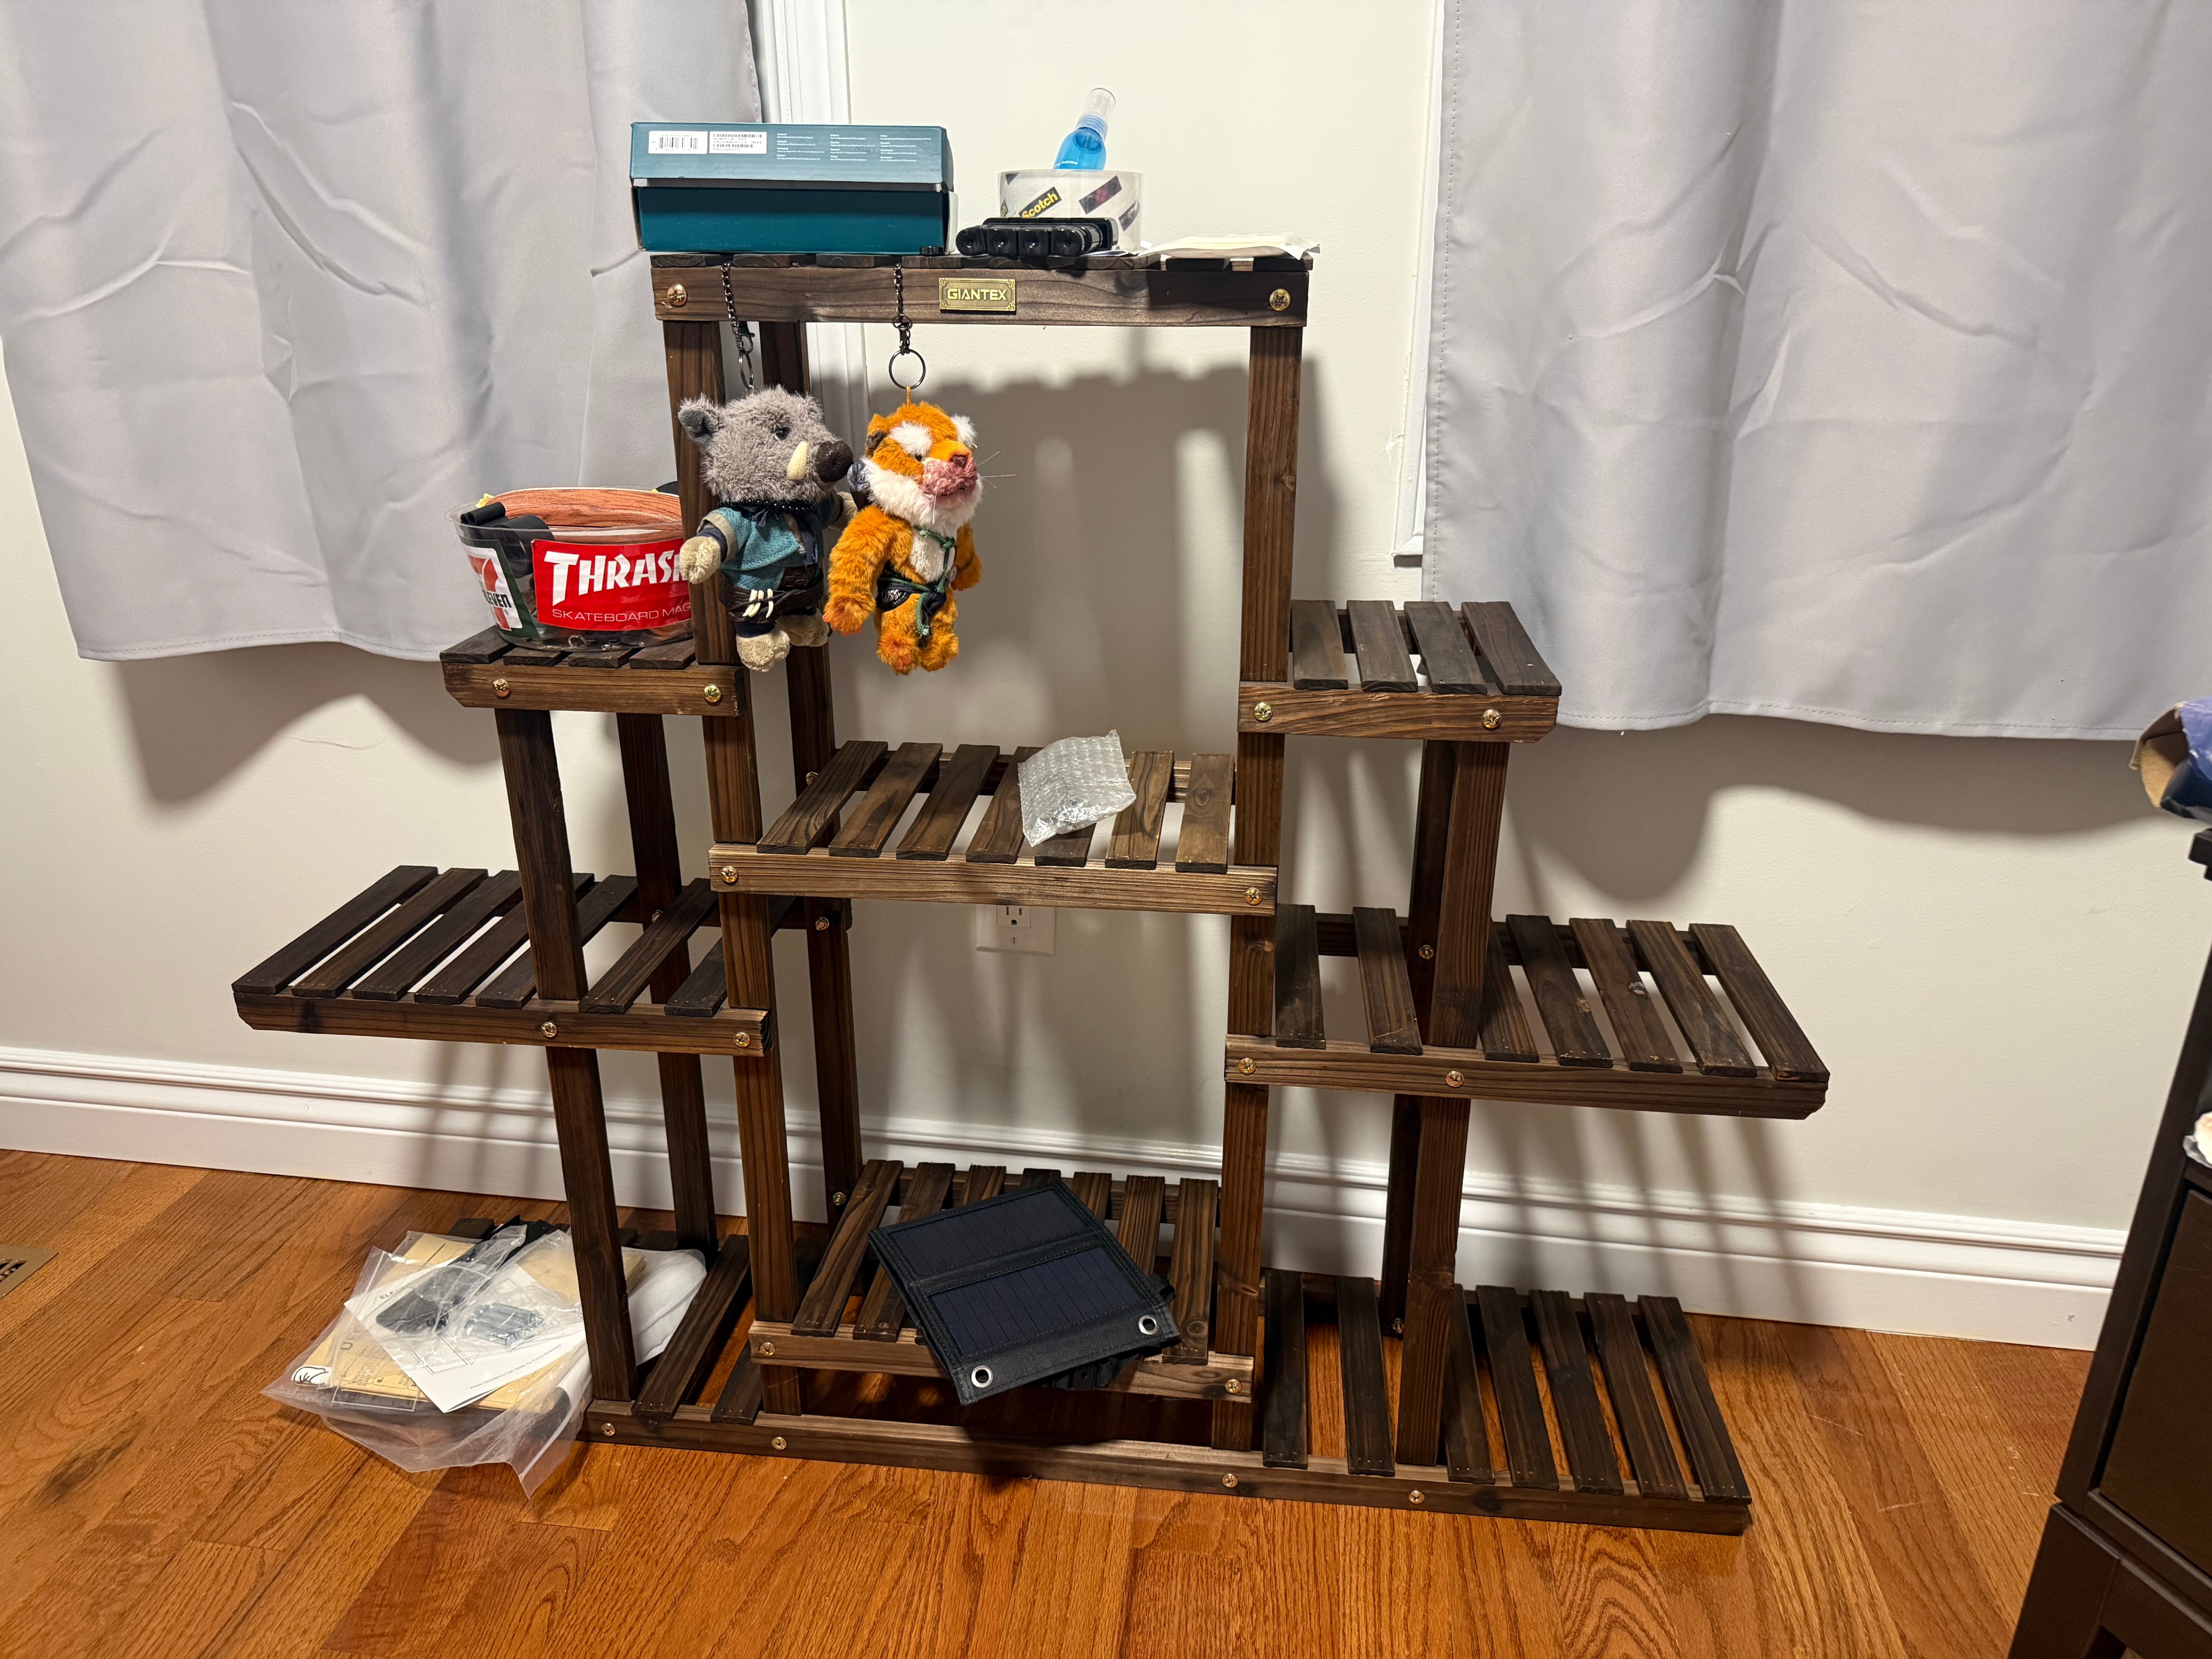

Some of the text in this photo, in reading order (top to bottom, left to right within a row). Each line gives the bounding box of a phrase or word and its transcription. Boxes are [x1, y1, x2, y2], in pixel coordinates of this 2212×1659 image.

[1022, 193, 1058, 218] Scotch
[947, 288, 1007, 300] GIANTEX
[552, 609, 659, 622] SKATEBOARD
